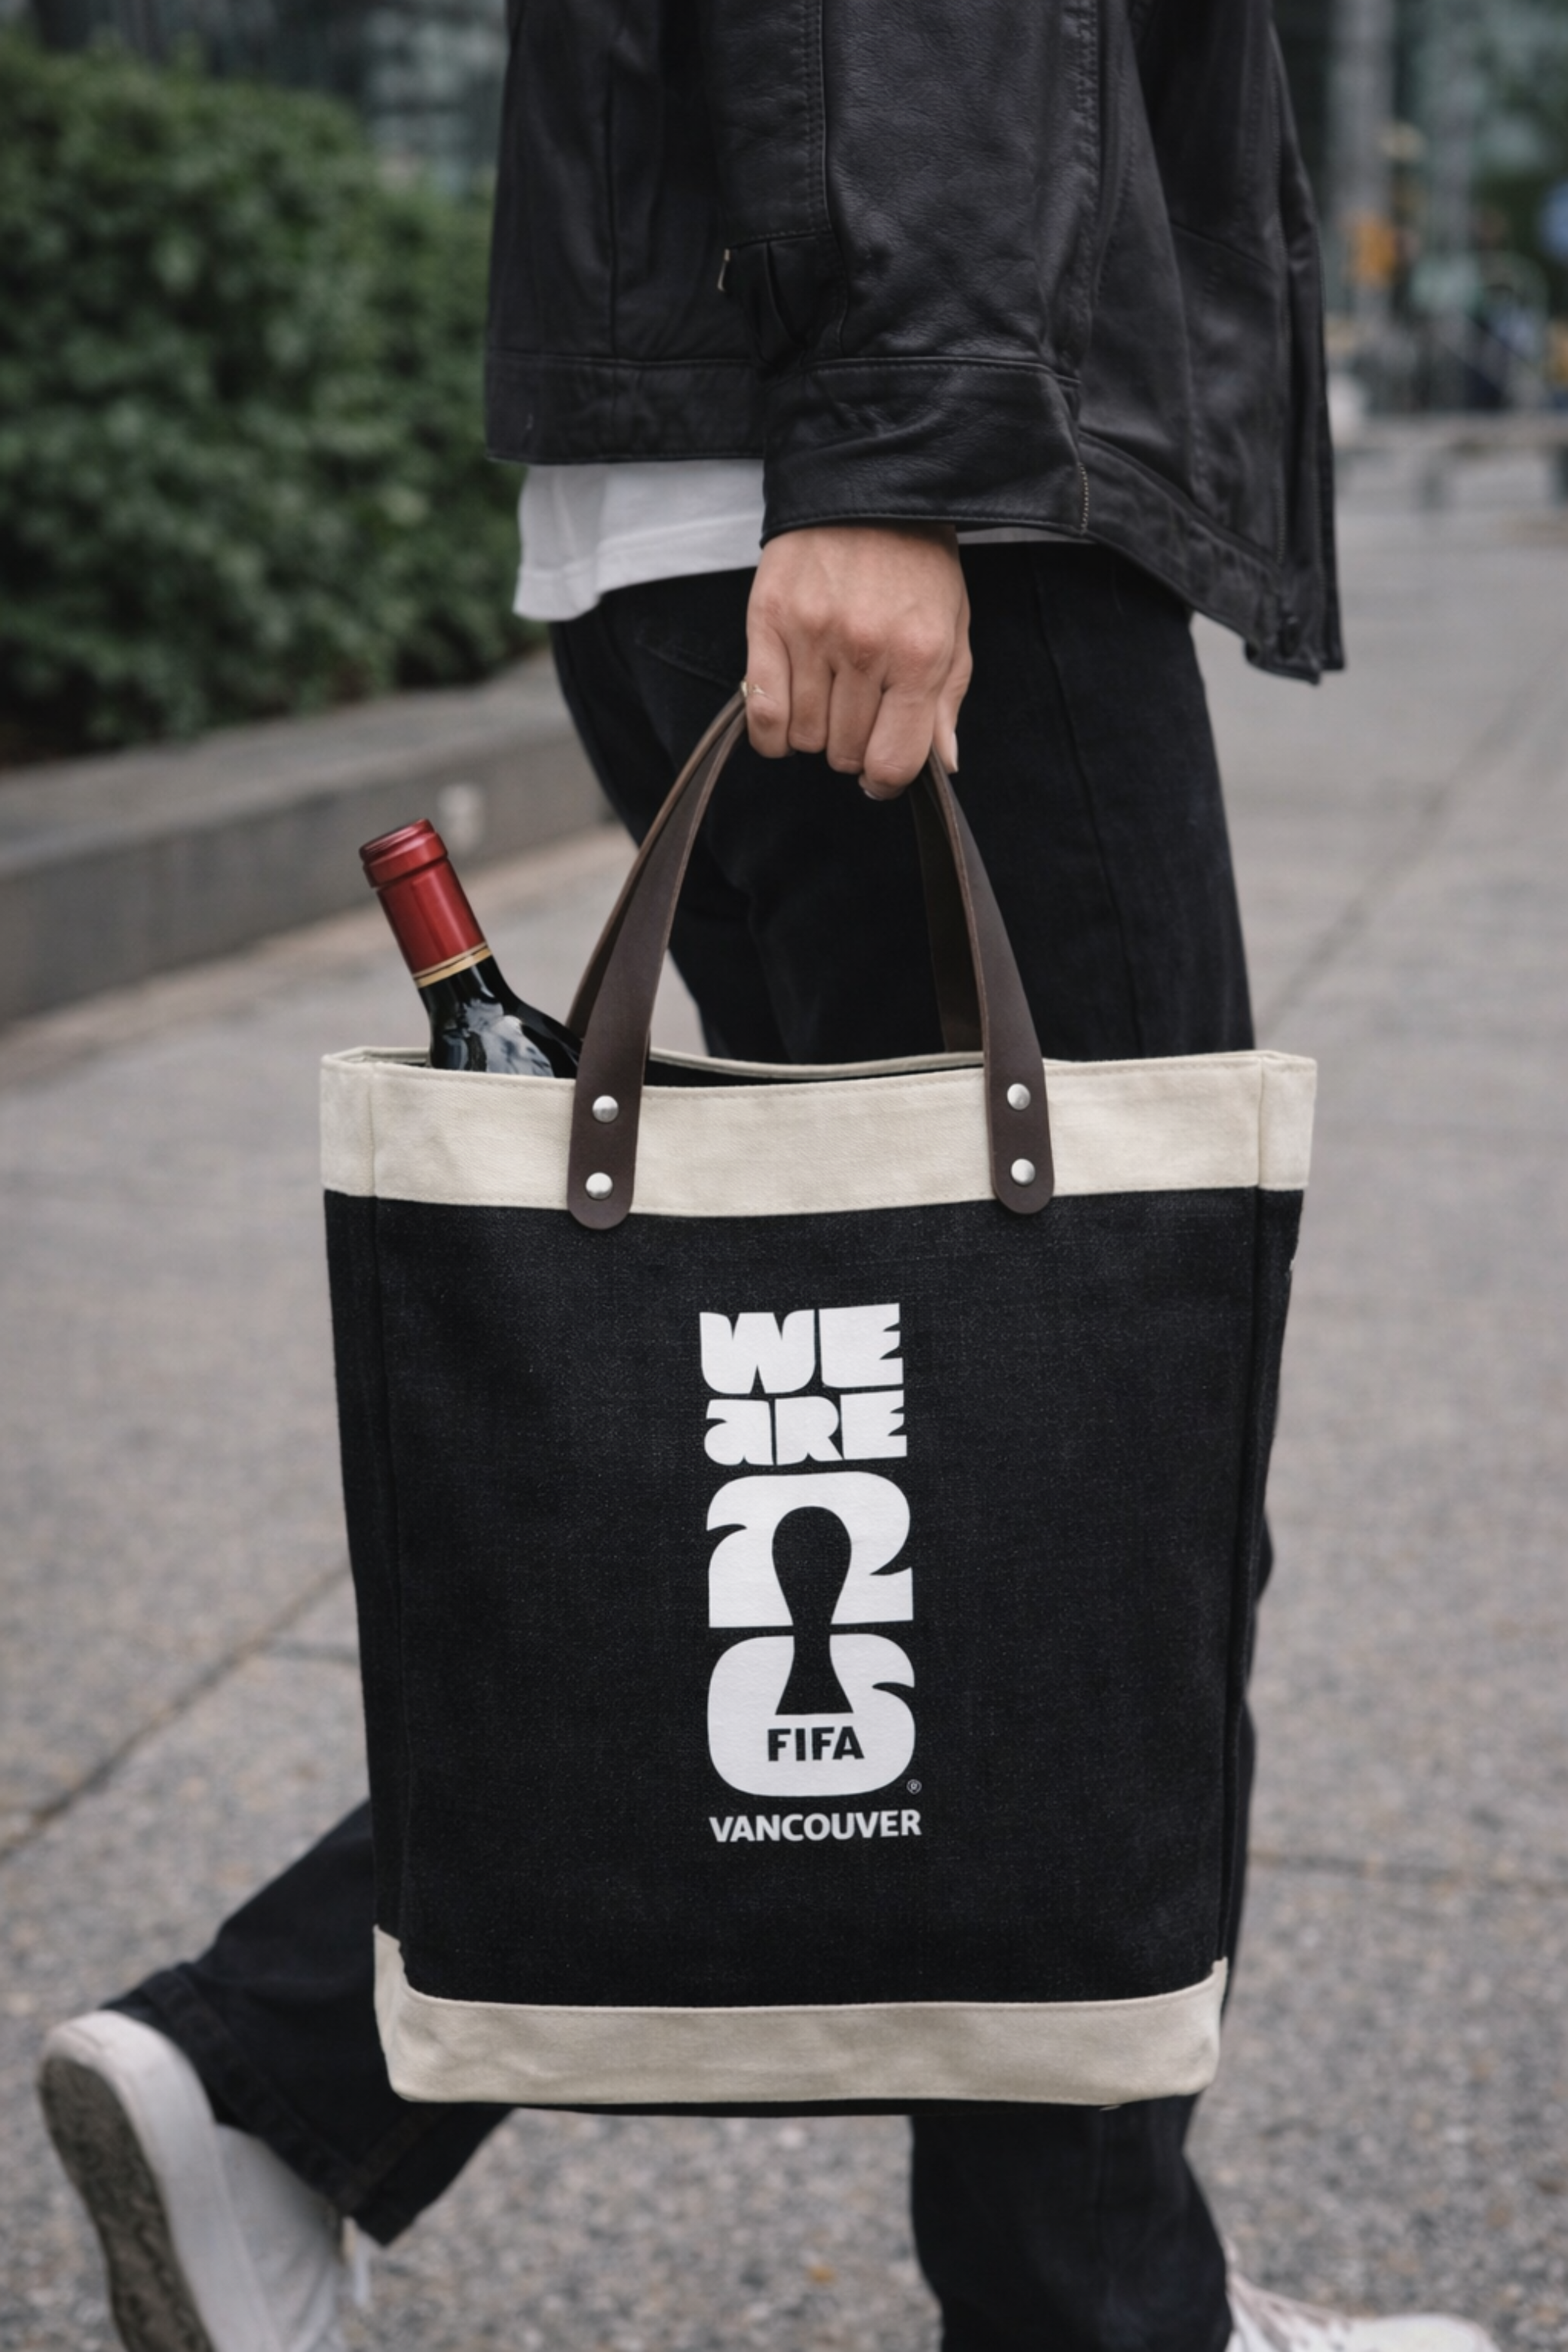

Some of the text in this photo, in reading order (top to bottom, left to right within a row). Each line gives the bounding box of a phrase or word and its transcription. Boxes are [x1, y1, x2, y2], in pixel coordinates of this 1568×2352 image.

[700, 1303, 904, 1395] WE
[767, 1726, 865, 1762] FIFA
[709, 1809, 921, 1842] VANCOUVER
